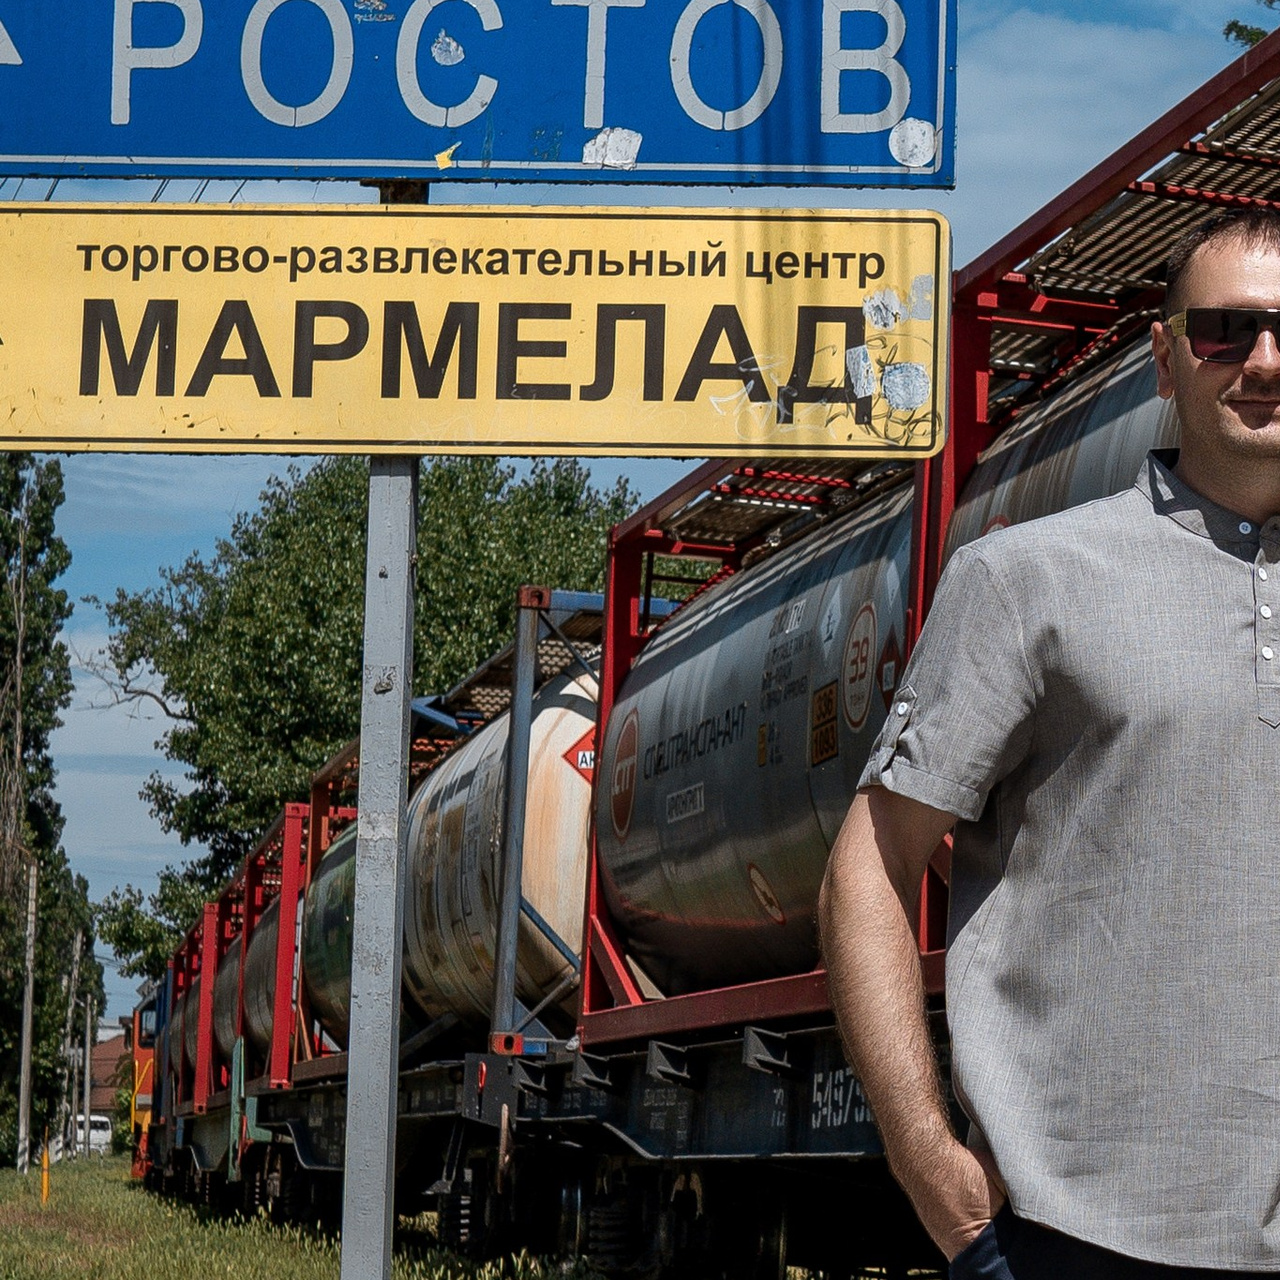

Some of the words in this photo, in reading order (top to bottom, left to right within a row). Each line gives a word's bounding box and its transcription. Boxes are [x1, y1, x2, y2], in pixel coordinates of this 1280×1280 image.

[76, 240, 727, 282] торгово-развлекательный
[745, 249, 886, 289] центр
[79, 298, 873, 425] МАРМЕЛАД
[849, 636, 870, 685] 39
